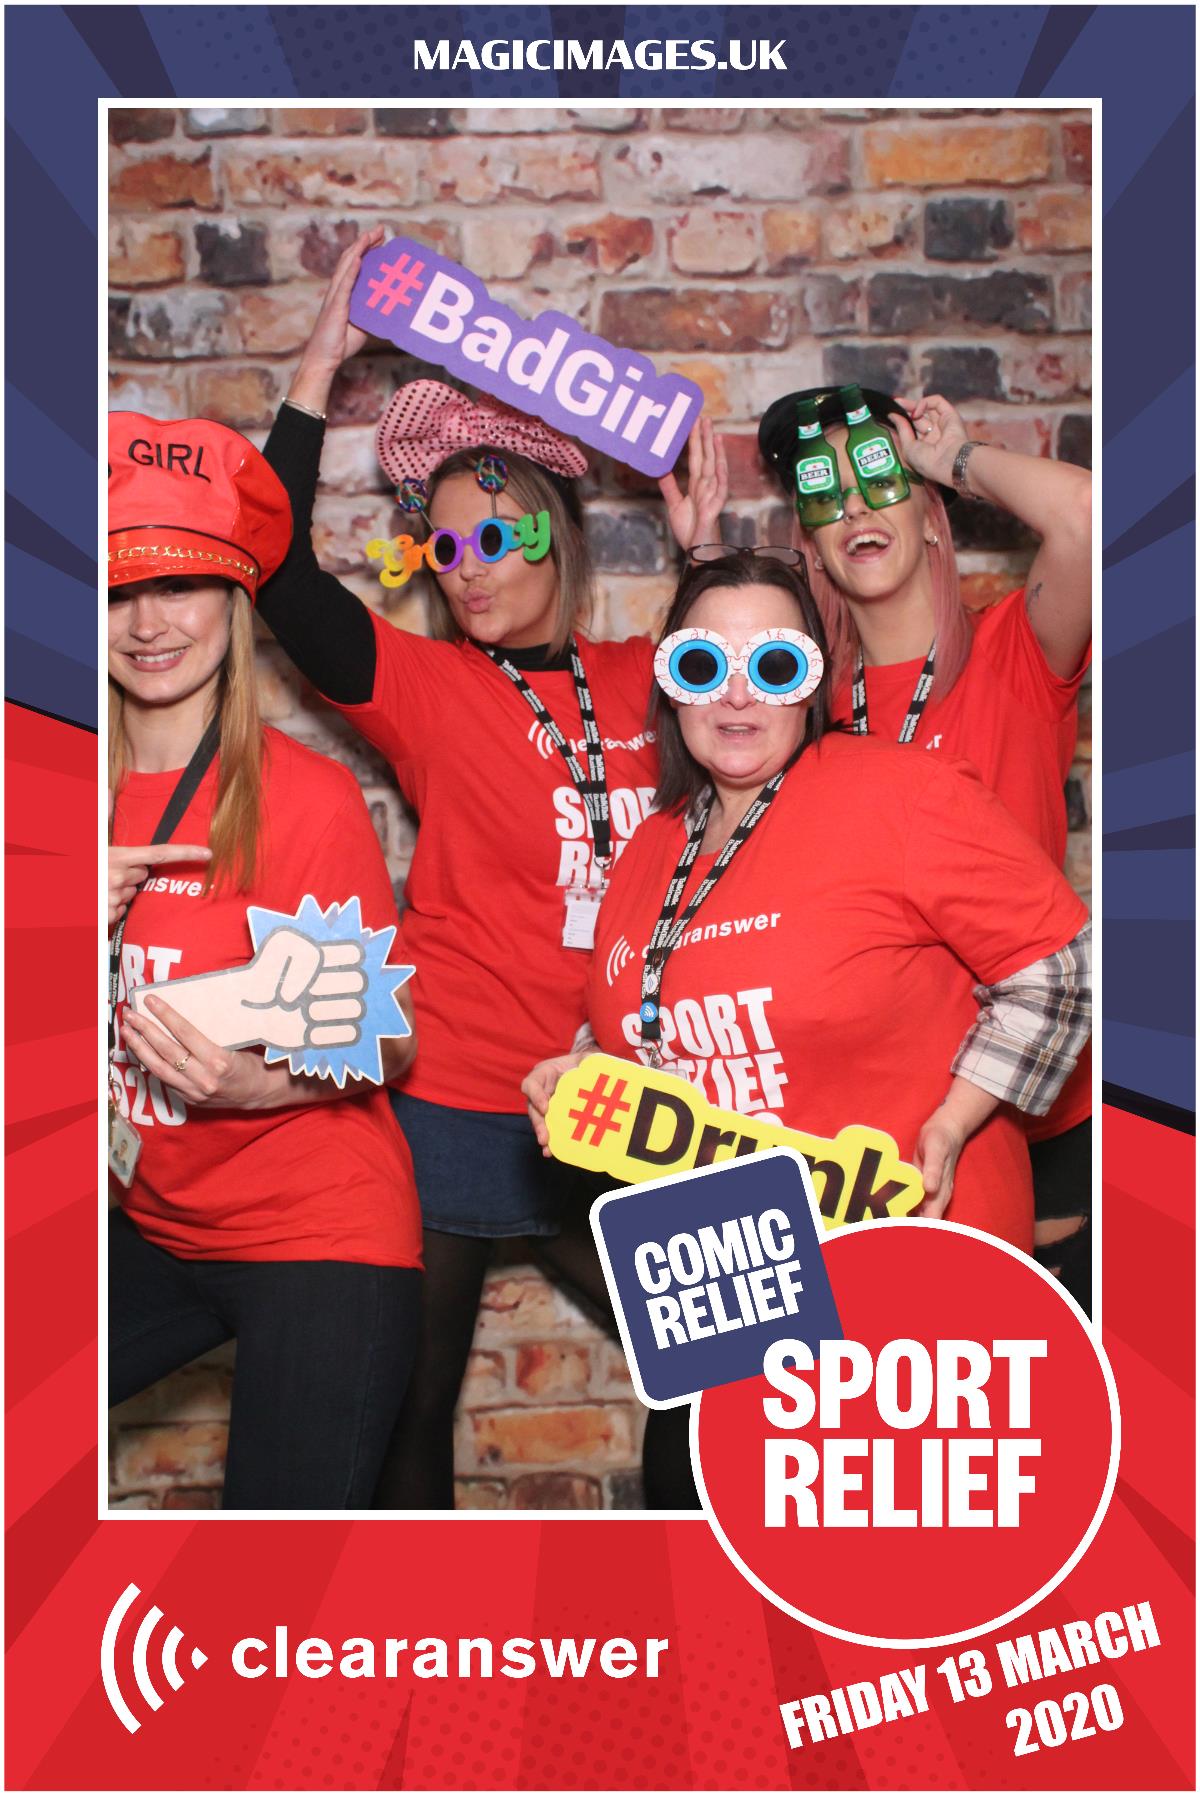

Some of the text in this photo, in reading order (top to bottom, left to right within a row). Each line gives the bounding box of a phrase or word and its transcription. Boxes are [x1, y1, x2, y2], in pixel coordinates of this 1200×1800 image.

[366, 253, 692, 458] #BadGirl
[128, 438, 211, 484] GIRL
[800, 468, 830, 481] BEER
[860, 448, 890, 467] BEER
[568, 1072, 910, 1224] #Drnk
